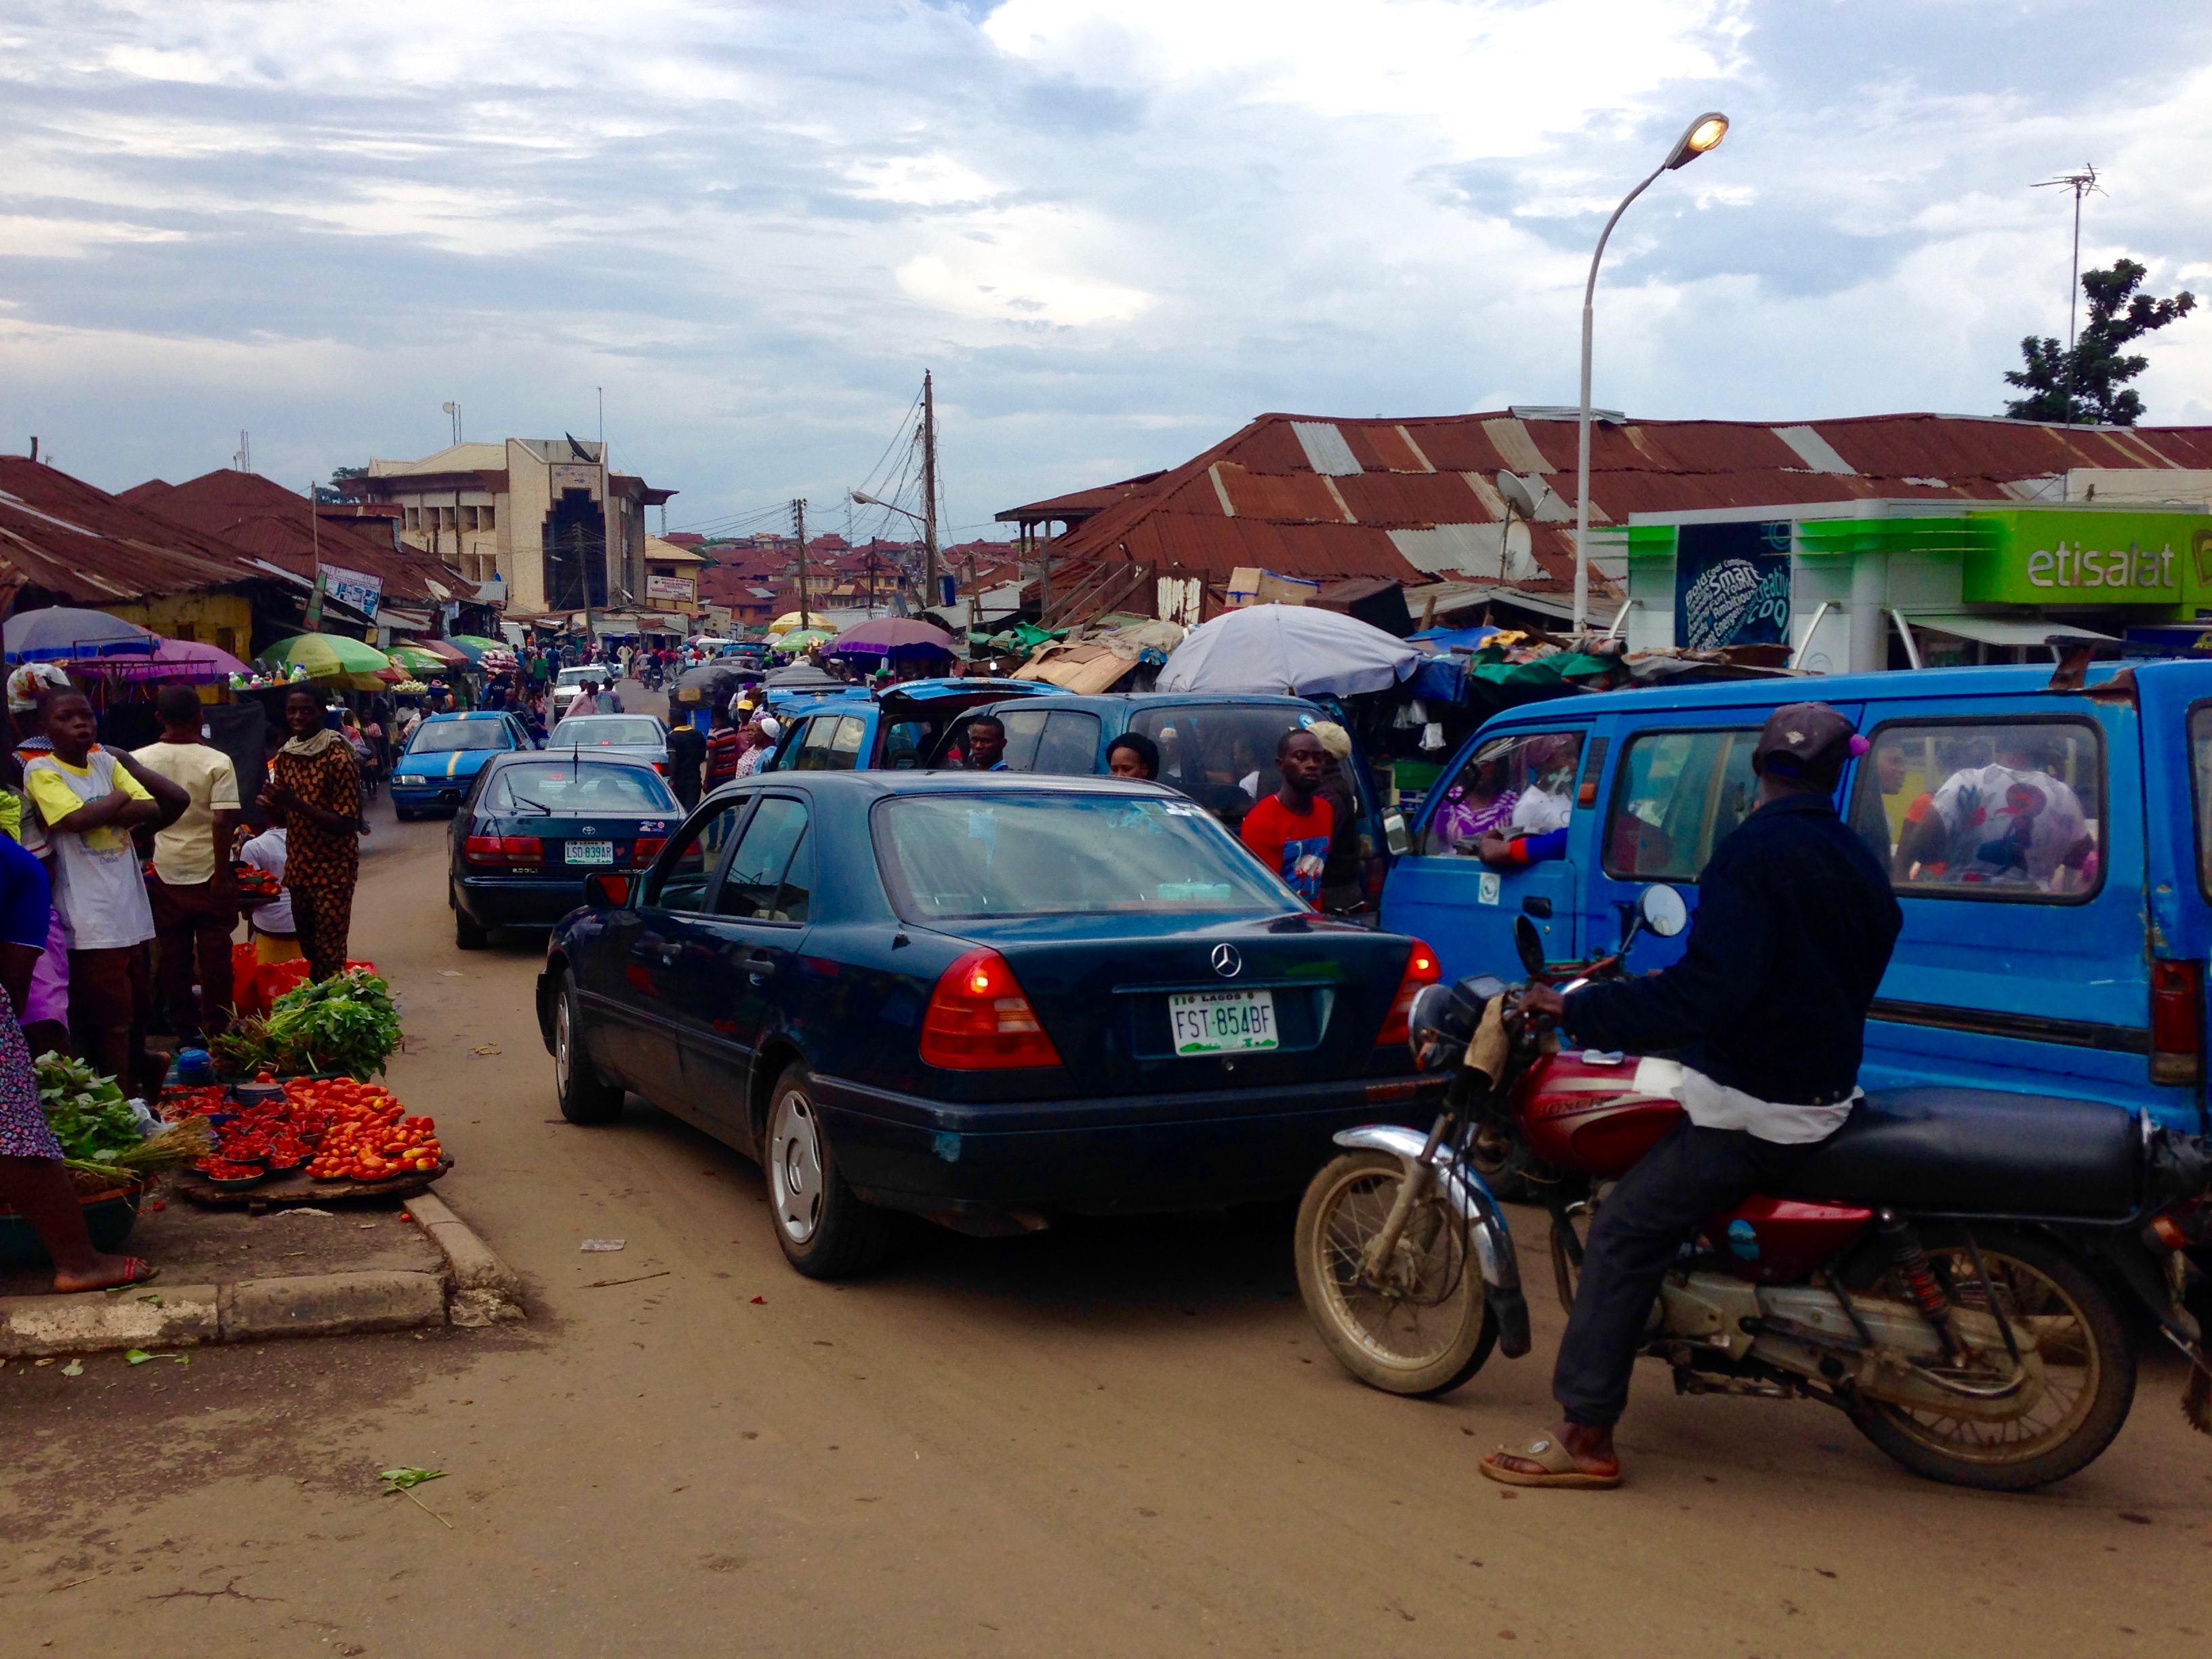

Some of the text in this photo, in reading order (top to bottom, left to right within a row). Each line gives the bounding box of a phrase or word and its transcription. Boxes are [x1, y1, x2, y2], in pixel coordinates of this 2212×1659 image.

[2028, 541, 2175, 587] etisalat
[1685, 572, 1708, 605] Bold
[1709, 567, 1763, 596] Smart
[1709, 593, 1727, 610] Fun
[1725, 579, 1758, 596] Young
[1712, 588, 1757, 619] Ambitious
[1201, 993, 1242, 1002] LAGOS
